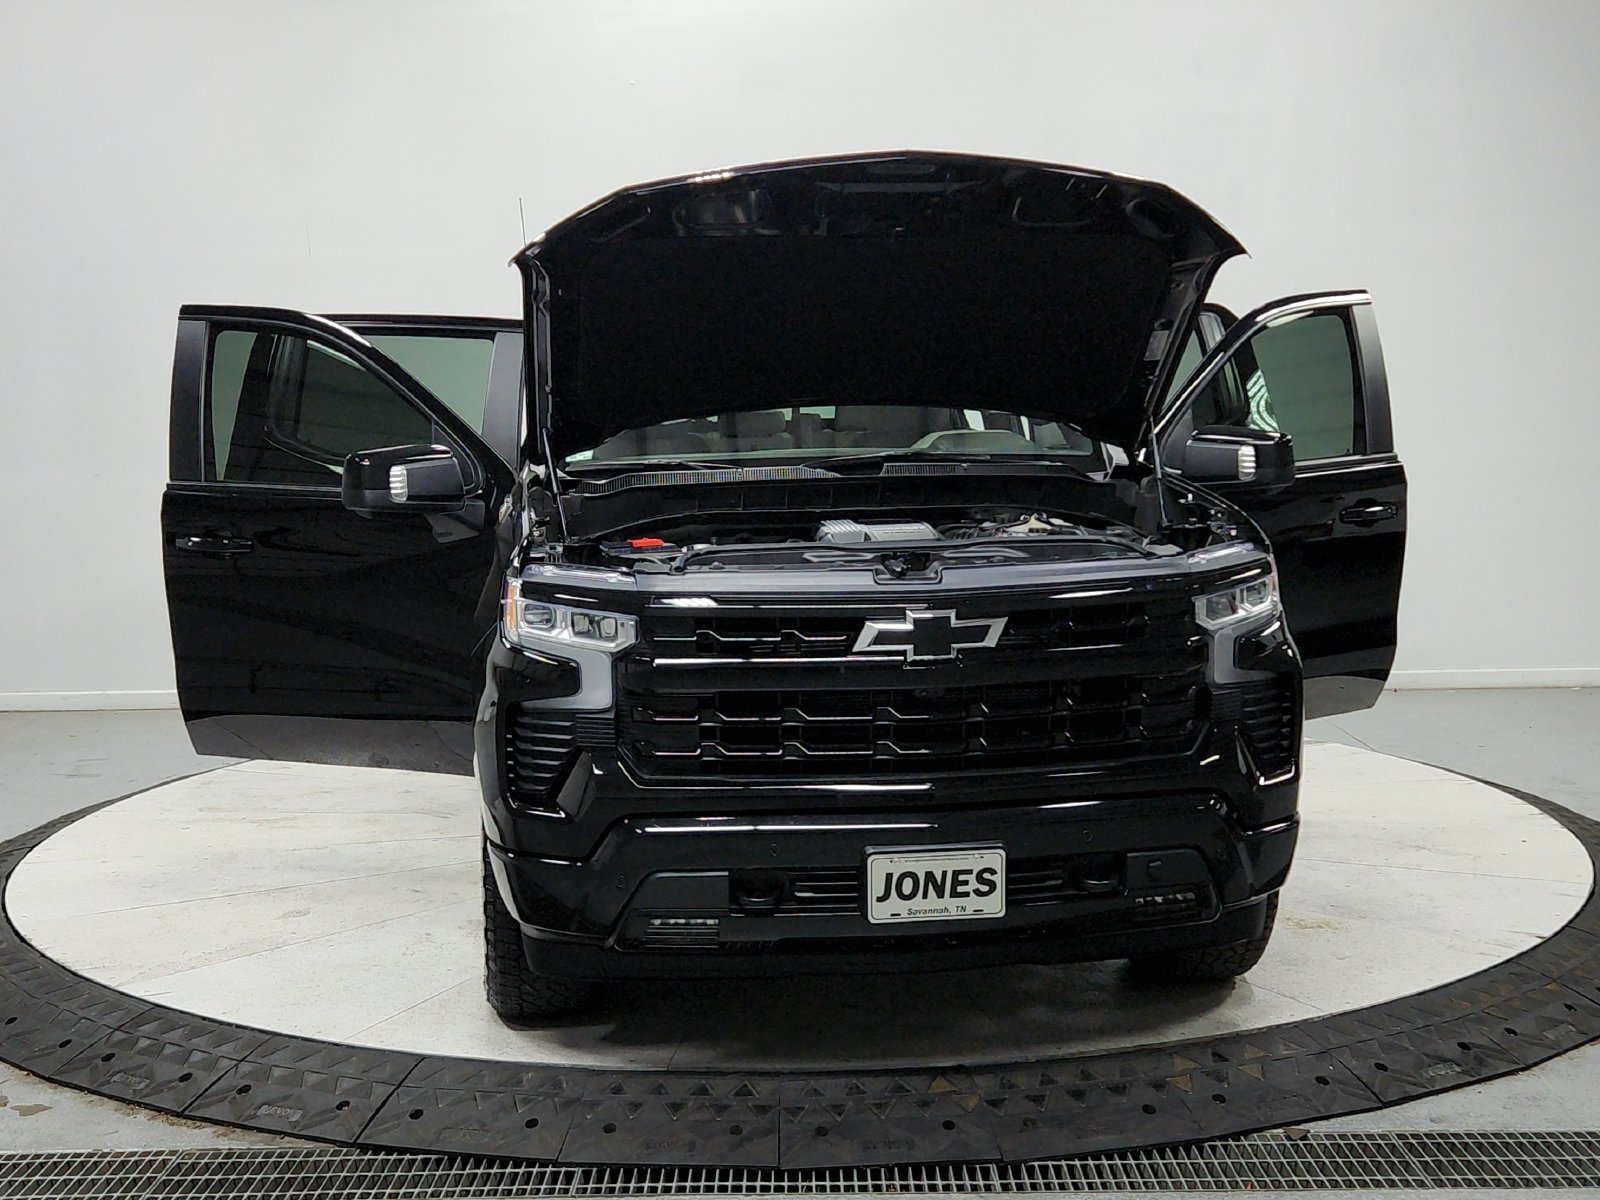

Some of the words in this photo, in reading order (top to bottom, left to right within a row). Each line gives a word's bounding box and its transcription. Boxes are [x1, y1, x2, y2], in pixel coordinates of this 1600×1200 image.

[876, 867, 998, 903] JONES
[907, 906, 952, 915] Savannah,
[955, 905, 967, 913] TN
